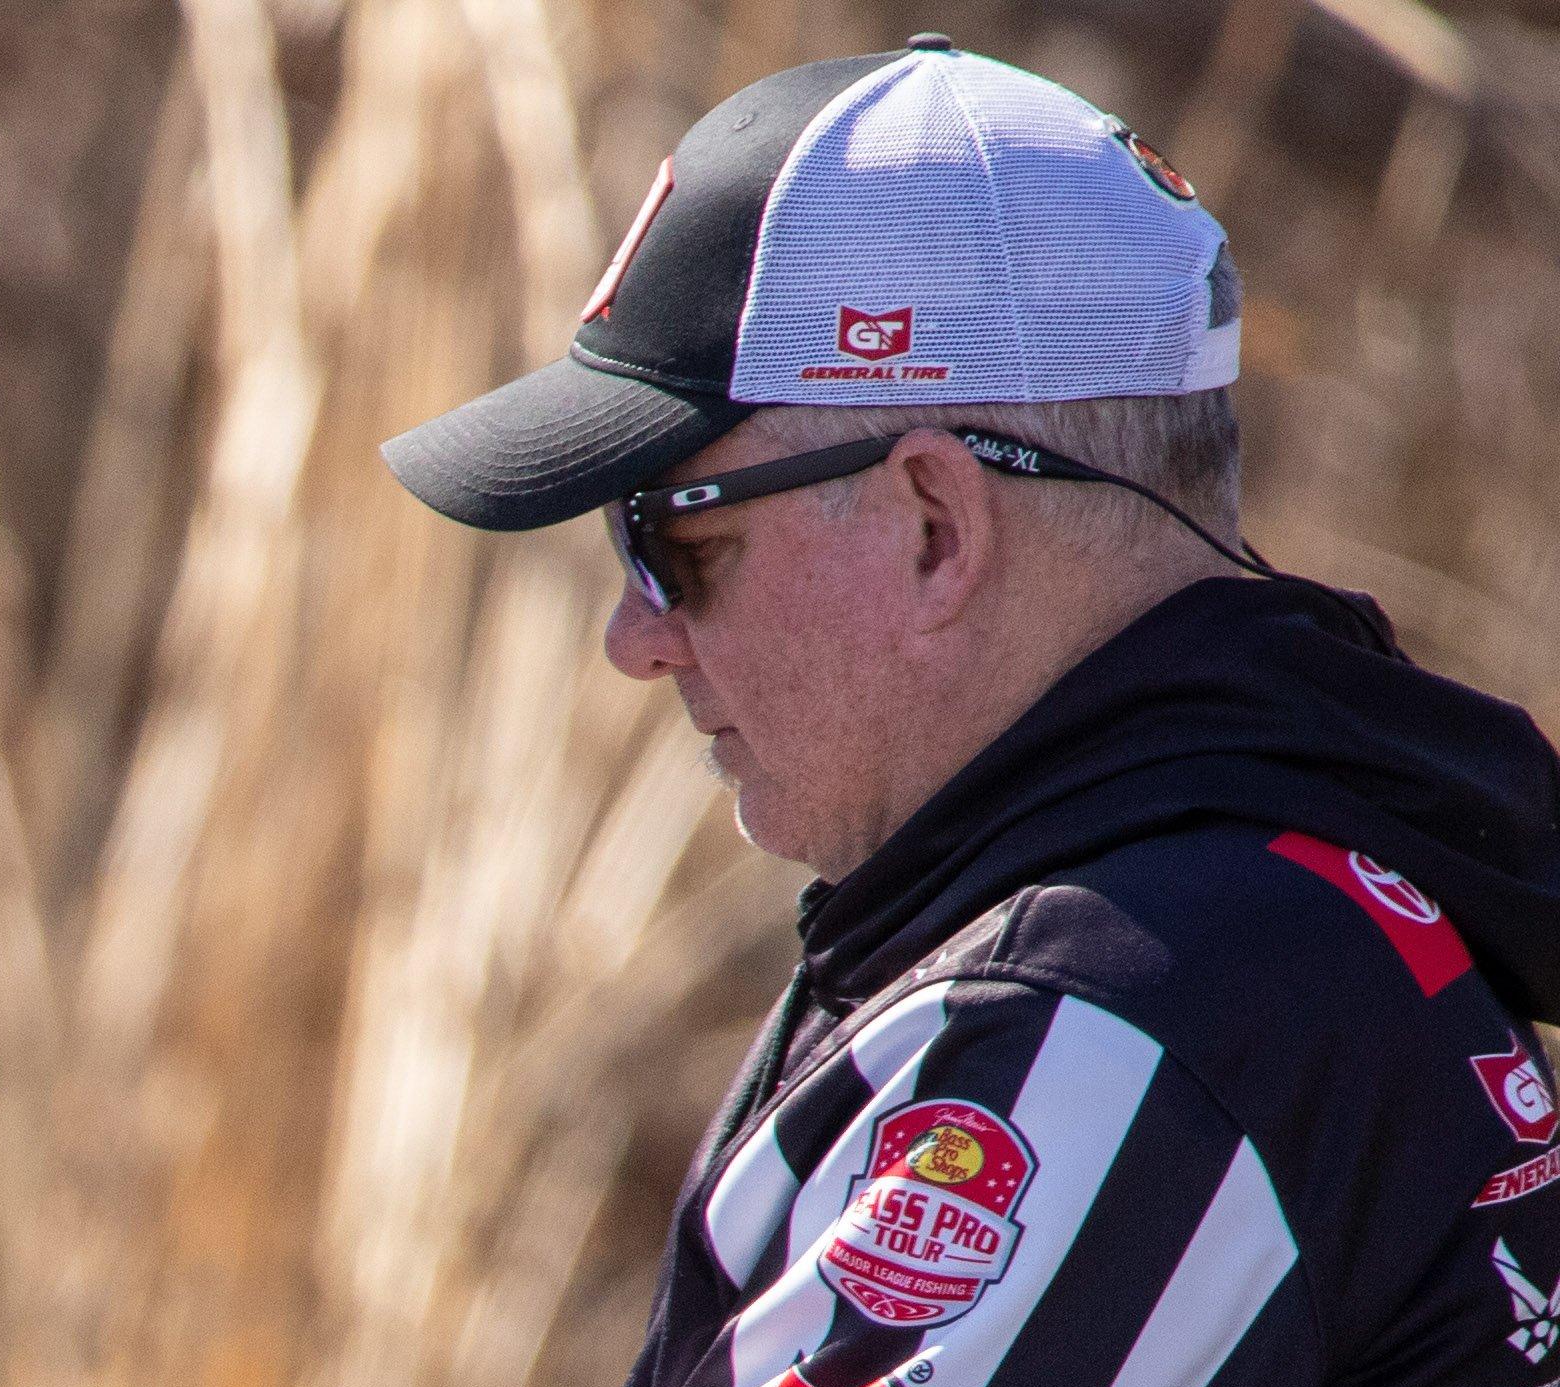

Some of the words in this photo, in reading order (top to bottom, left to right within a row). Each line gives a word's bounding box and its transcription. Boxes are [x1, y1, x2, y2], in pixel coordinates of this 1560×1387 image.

[800, 366, 896, 381] GENERAL
[900, 366, 949, 381] TIRE
[874, 1223, 946, 1263] TOUR
[929, 1202, 1002, 1256] PRO
[832, 1246, 871, 1275] MAJOR
[874, 1264, 912, 1288] LEAGUE
[913, 1277, 966, 1297] FISHING
